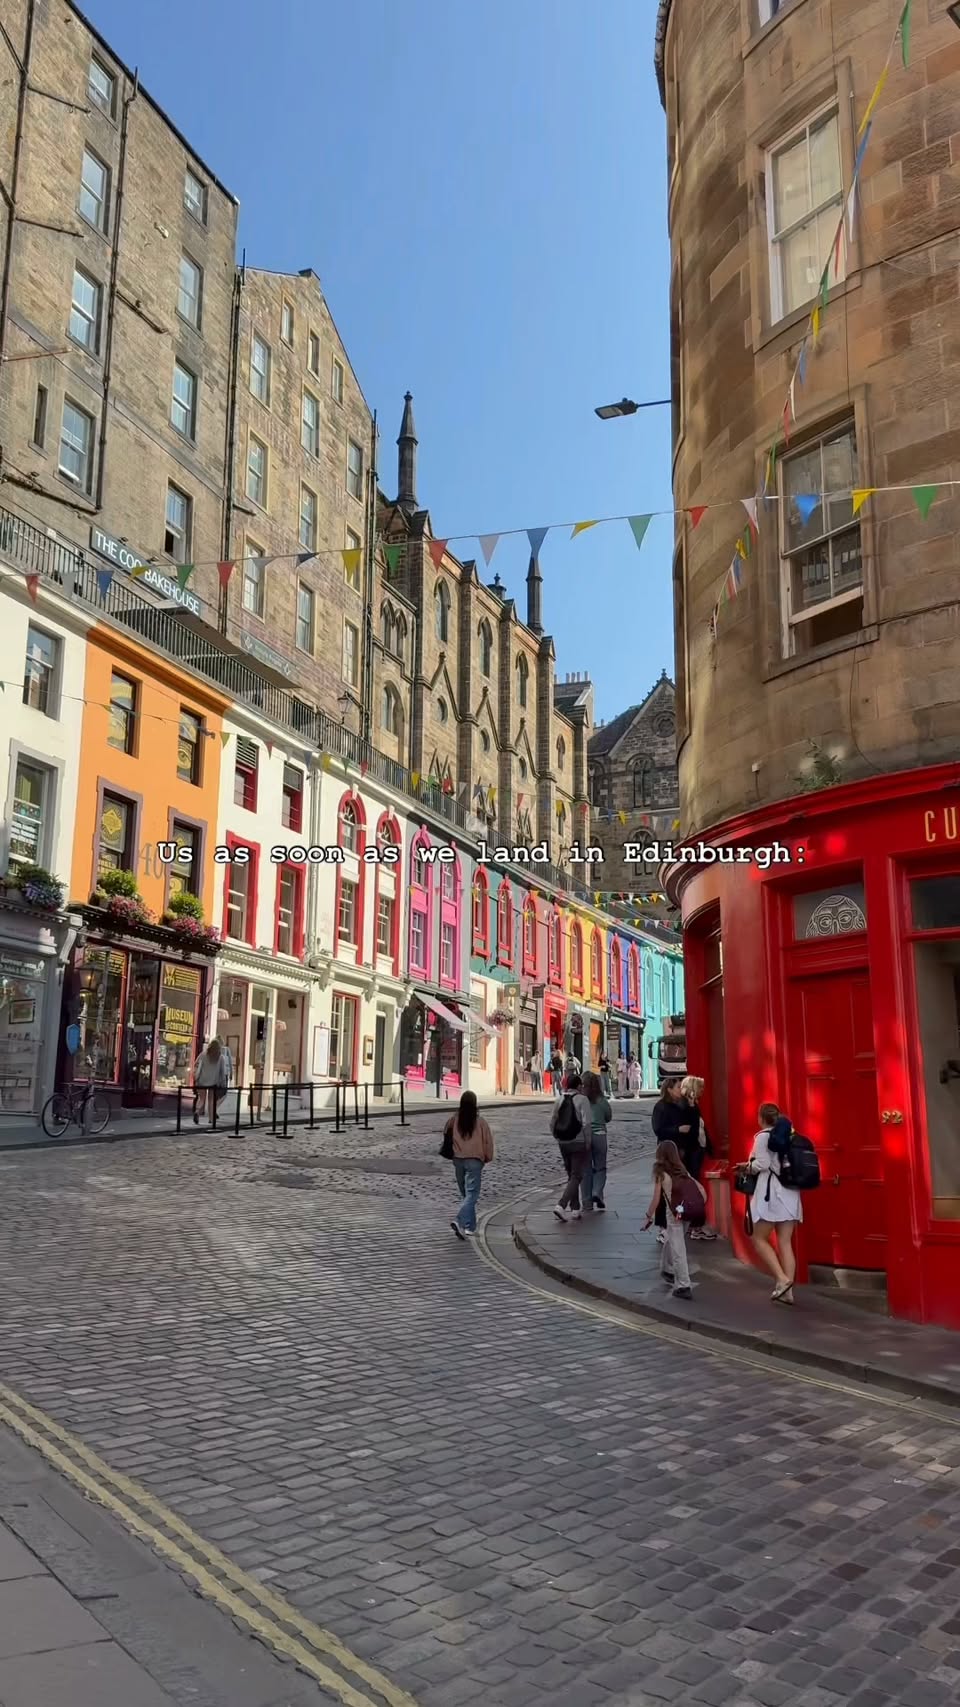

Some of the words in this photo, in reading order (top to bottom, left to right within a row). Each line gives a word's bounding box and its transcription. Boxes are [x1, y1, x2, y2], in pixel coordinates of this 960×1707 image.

[95, 530, 118, 559] THE
[144, 568, 200, 616] BAKEHOUSE
[924, 806, 957, 842] CU
[165, 1006, 194, 1026] MUSEUM
